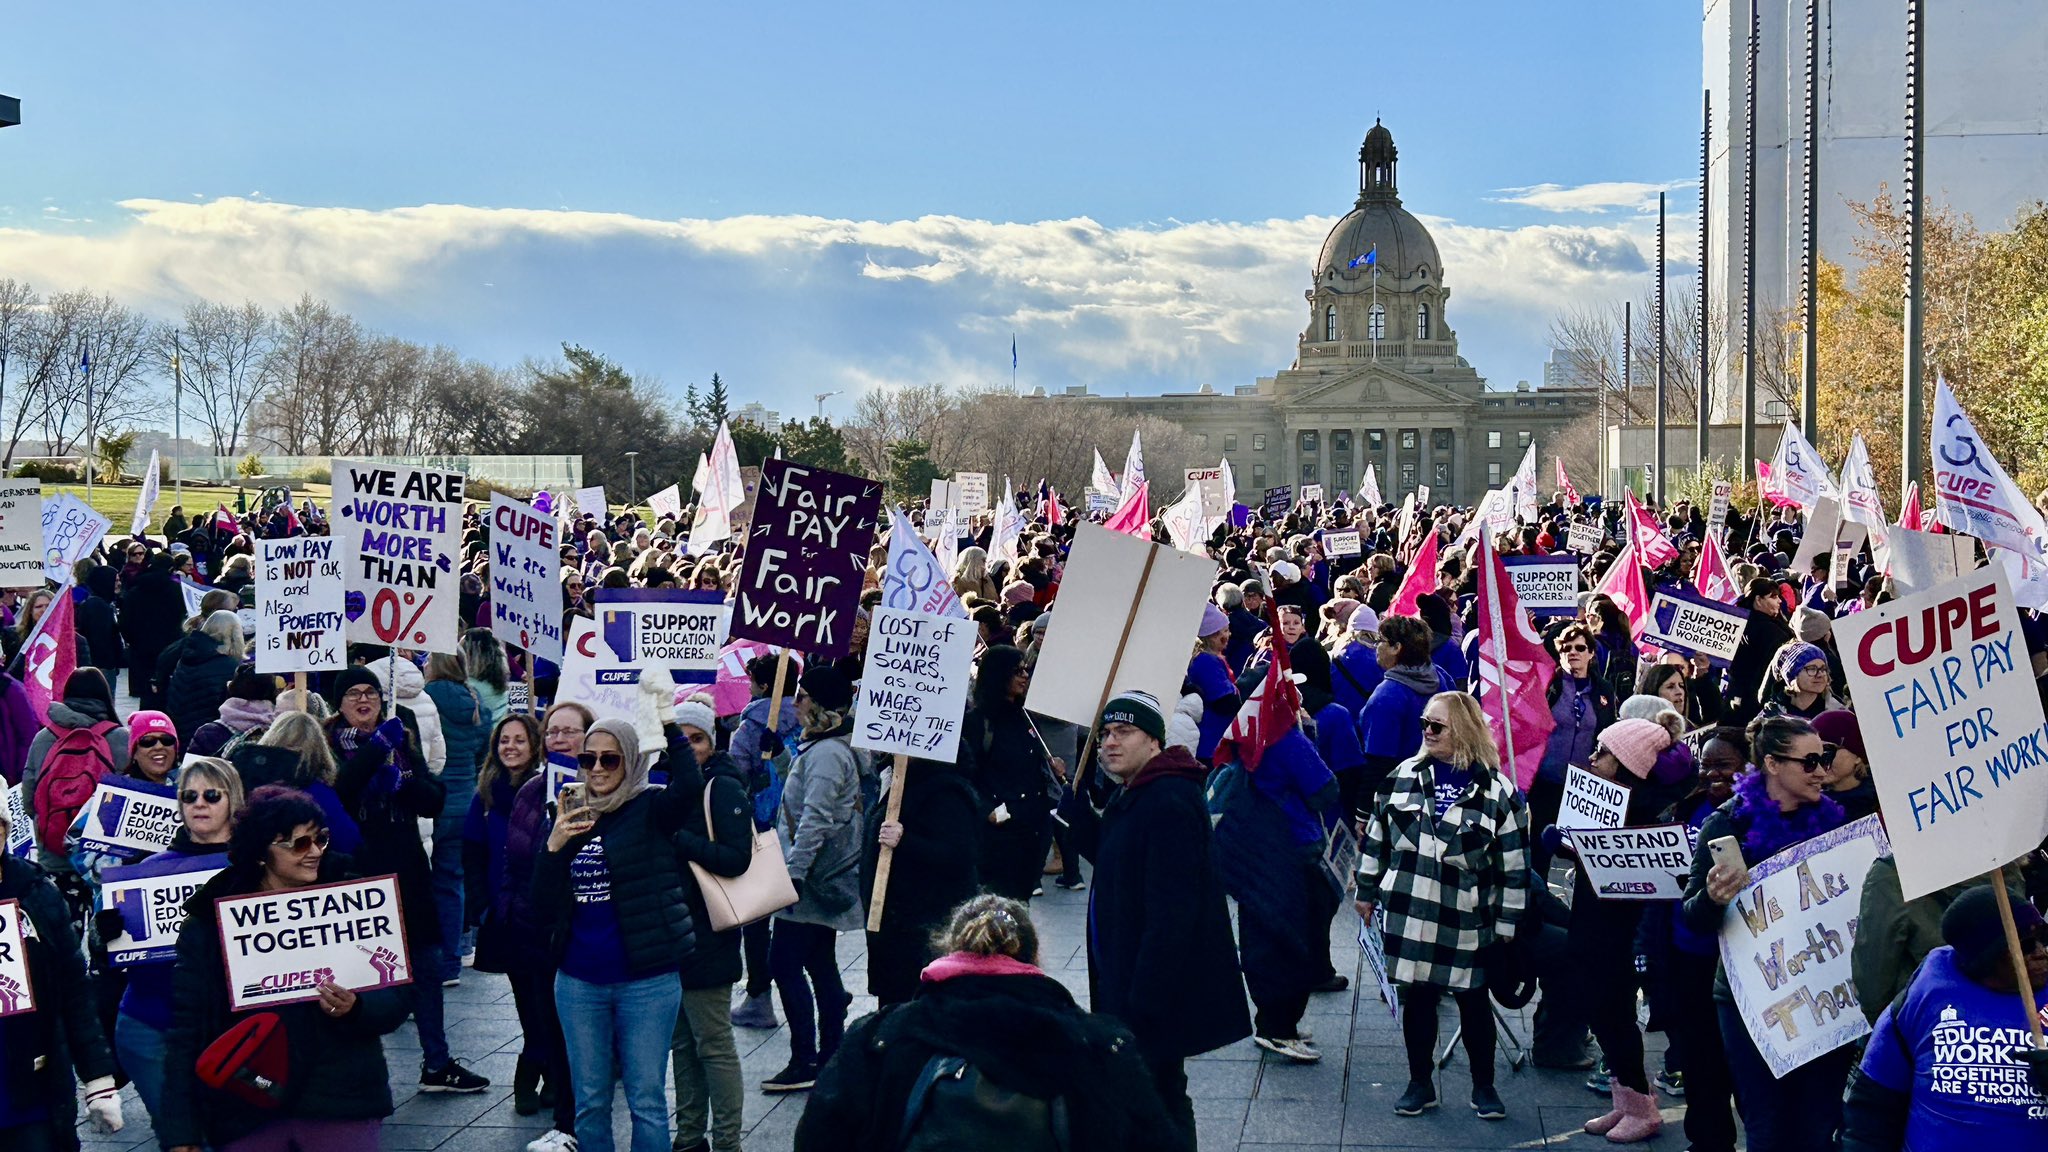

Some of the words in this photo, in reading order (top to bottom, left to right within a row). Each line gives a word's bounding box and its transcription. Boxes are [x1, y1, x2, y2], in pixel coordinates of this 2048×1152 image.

[350, 468, 396, 497] WE
[401, 470, 463, 504] ARE
[1188, 470, 1221, 481] CUPE
[1936, 471, 1996, 500] CUPE
[777, 467, 857, 517] Fair
[353, 497, 446, 533] WORTH
[495, 505, 554, 550] CUPE
[787, 510, 850, 548] PAY
[264, 543, 297, 561] LOW
[303, 540, 332, 560] PAY
[361, 528, 433, 562] MORE
[266, 564, 278, 580] is
[284, 560, 315, 580] NOT
[496, 541, 516, 568] We
[523, 556, 546, 578] are
[359, 554, 437, 589] THAN
[755, 548, 841, 604] Fair
[1516, 571, 1573, 583] SUPPORT
[283, 580, 309, 596] and
[1516, 583, 1573, 592] EDUCATION
[265, 599, 293, 616] Also
[372, 587, 433, 644] 0%
[495, 602, 530, 630] More
[279, 612, 343, 631] POVERTY
[641, 614, 717, 631] SUPPORT
[879, 614, 928, 638] COST
[932, 623, 955, 643] of
[1677, 620, 1737, 644] EDUCATION
[1680, 609, 1740, 635] SUPPORT
[1857, 582, 2000, 677] CUPE
[268, 634, 280, 650] is
[287, 630, 325, 650] NOT
[641, 632, 716, 645] EDUCATION
[885, 637, 940, 661] LIVING
[601, 672, 632, 682] CUPE
[884, 675, 906, 688] as
[915, 681, 948, 695] our
[1884, 656, 1968, 739] FAIR
[1971, 630, 2014, 690] PAY
[869, 689, 922, 712] WAGES
[879, 709, 918, 730] STAY
[1114, 711, 1134, 723] GOLD
[1946, 707, 1999, 757] FOR
[1570, 770, 1586, 792] WE
[1587, 778, 1624, 807] STAND
[1908, 765, 1983, 832] FAIR
[130, 801, 183, 824] SUPPO
[1566, 790, 1620, 829] TOGETHER
[125, 827, 172, 846] WORKE
[126, 816, 178, 835] EDUCAT
[1577, 834, 1611, 850] WE
[1612, 831, 1680, 849] STAND
[1585, 851, 1689, 869] TOGETHER
[1609, 882, 1642, 892] CUPE
[229, 901, 280, 928] WE
[286, 887, 386, 921] STAND
[233, 915, 393, 956] TOGETHER
[115, 950, 148, 963] CUPE
[1753, 922, 1844, 991] Worth
[261, 970, 312, 989] CUPE
[1934, 1044, 2036, 1066] WORKE
[1931, 1066, 2028, 1083] TOGETHER
[1931, 1080, 1962, 1094] ARE
